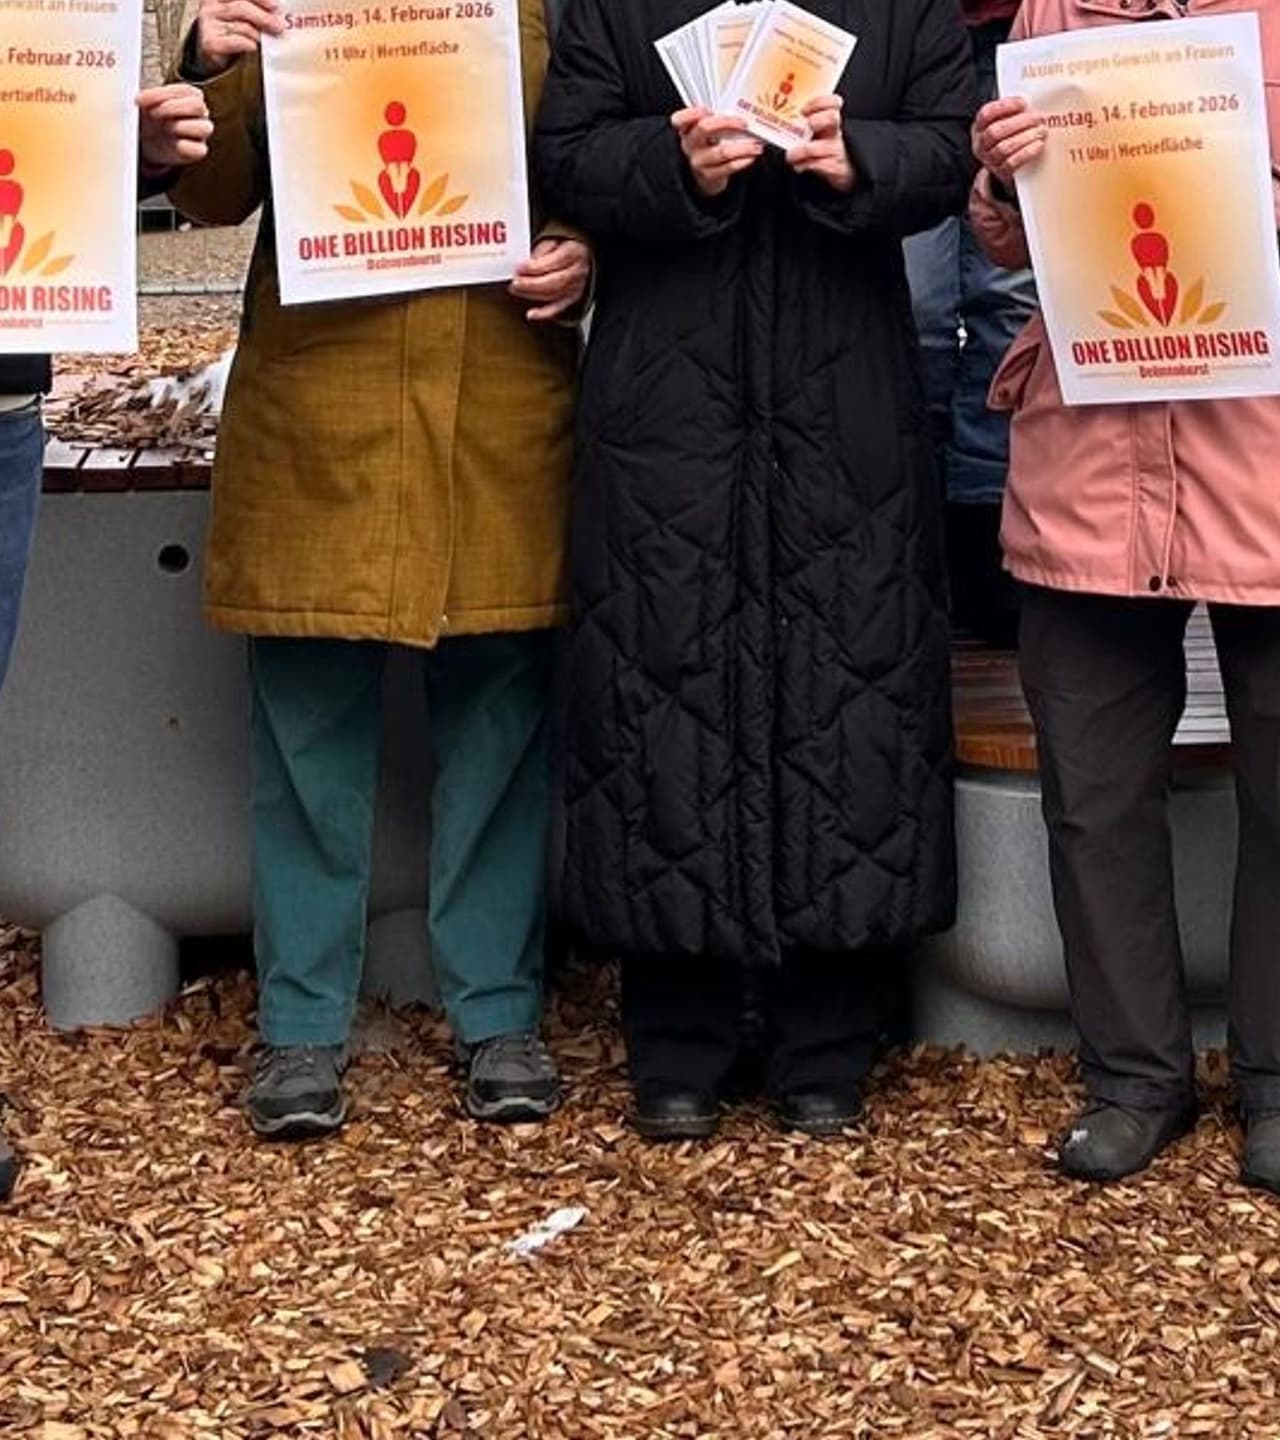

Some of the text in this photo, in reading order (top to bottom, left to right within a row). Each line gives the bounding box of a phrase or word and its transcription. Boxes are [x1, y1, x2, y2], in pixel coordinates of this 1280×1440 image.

[284, 2, 494, 30] Samstag, 14. Februar 2026
[8, 48, 72, 66] Februar
[76, 50, 116, 67] 2026
[325, 41, 459, 61] 11 Uhr Hertiefläche
[1101, 106, 1126, 123] 14.
[1129, 100, 1194, 120] Februar
[1198, 94, 1239, 112] 2026
[1069, 137, 1203, 163] 11 Uhr Hertiefläche
[299, 222, 507, 260] ONE BILLION RISING
[32, 286, 113, 311] RISING
[1072, 332, 1269, 366] ONE BILLION RISING
